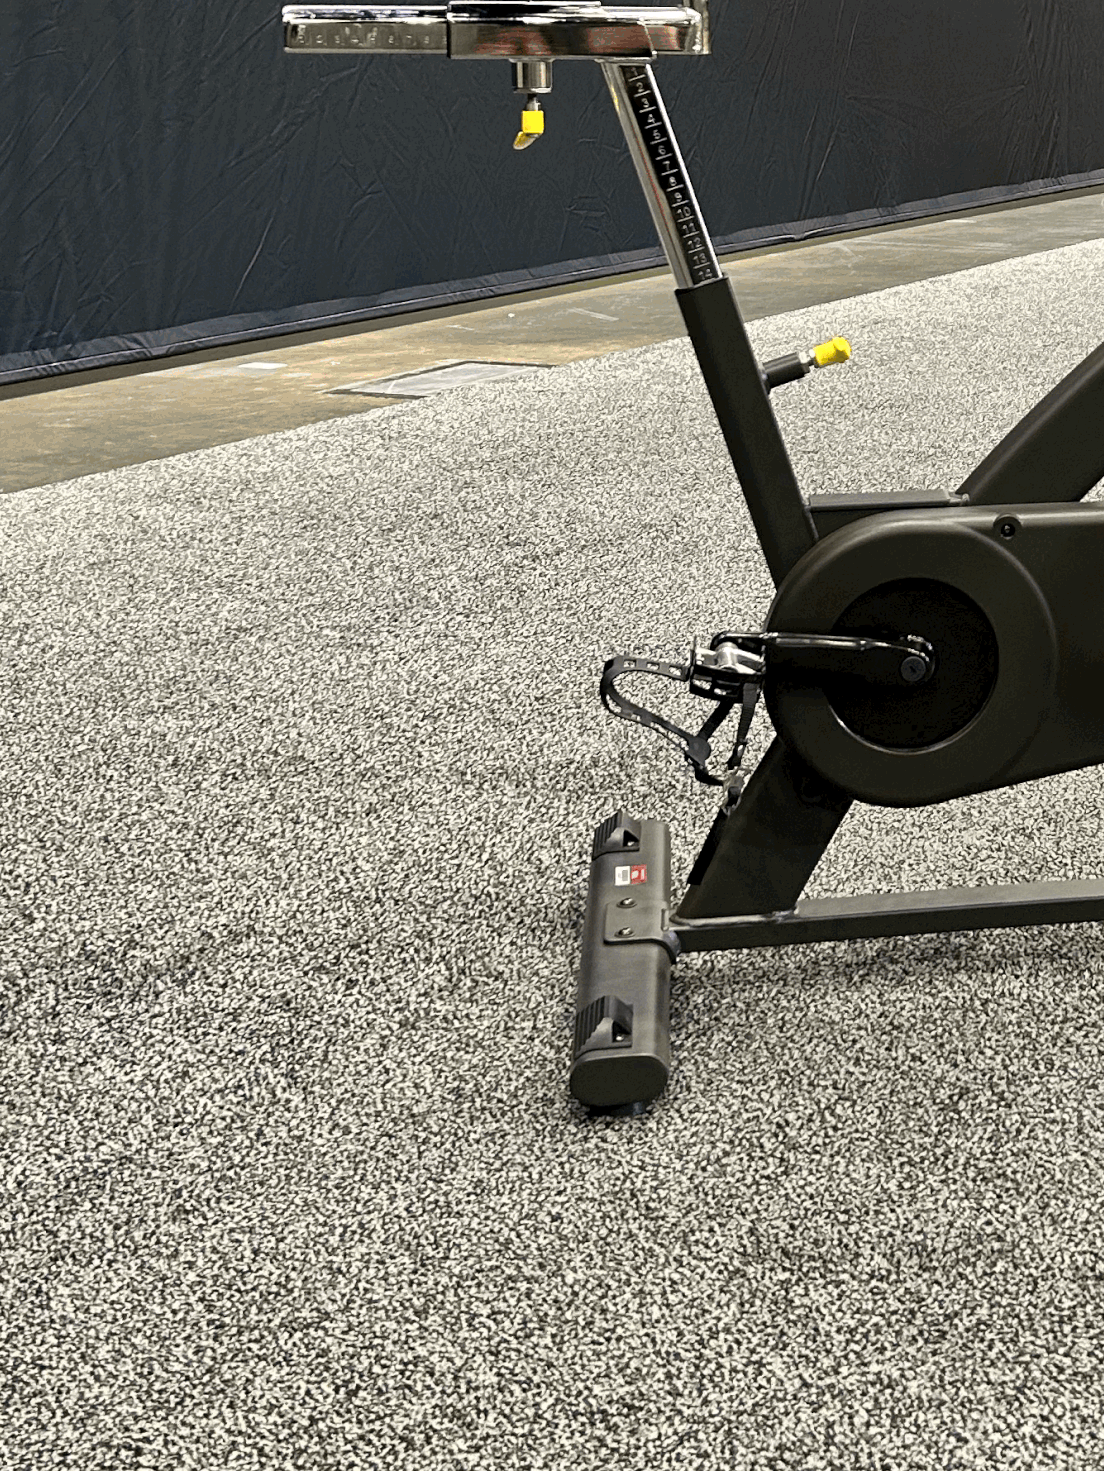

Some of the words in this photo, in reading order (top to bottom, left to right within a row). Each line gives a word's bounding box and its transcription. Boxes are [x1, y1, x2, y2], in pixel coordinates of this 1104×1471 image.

[635, 81, 644, 92] 2
[641, 97, 650, 108] 3
[647, 113, 656, 124] 4
[652, 129, 661, 140] 5
[658, 145, 667, 155] 6
[668, 176, 677, 187] 8
[673, 191, 683, 202] 9
[676, 206, 691, 219] 10
